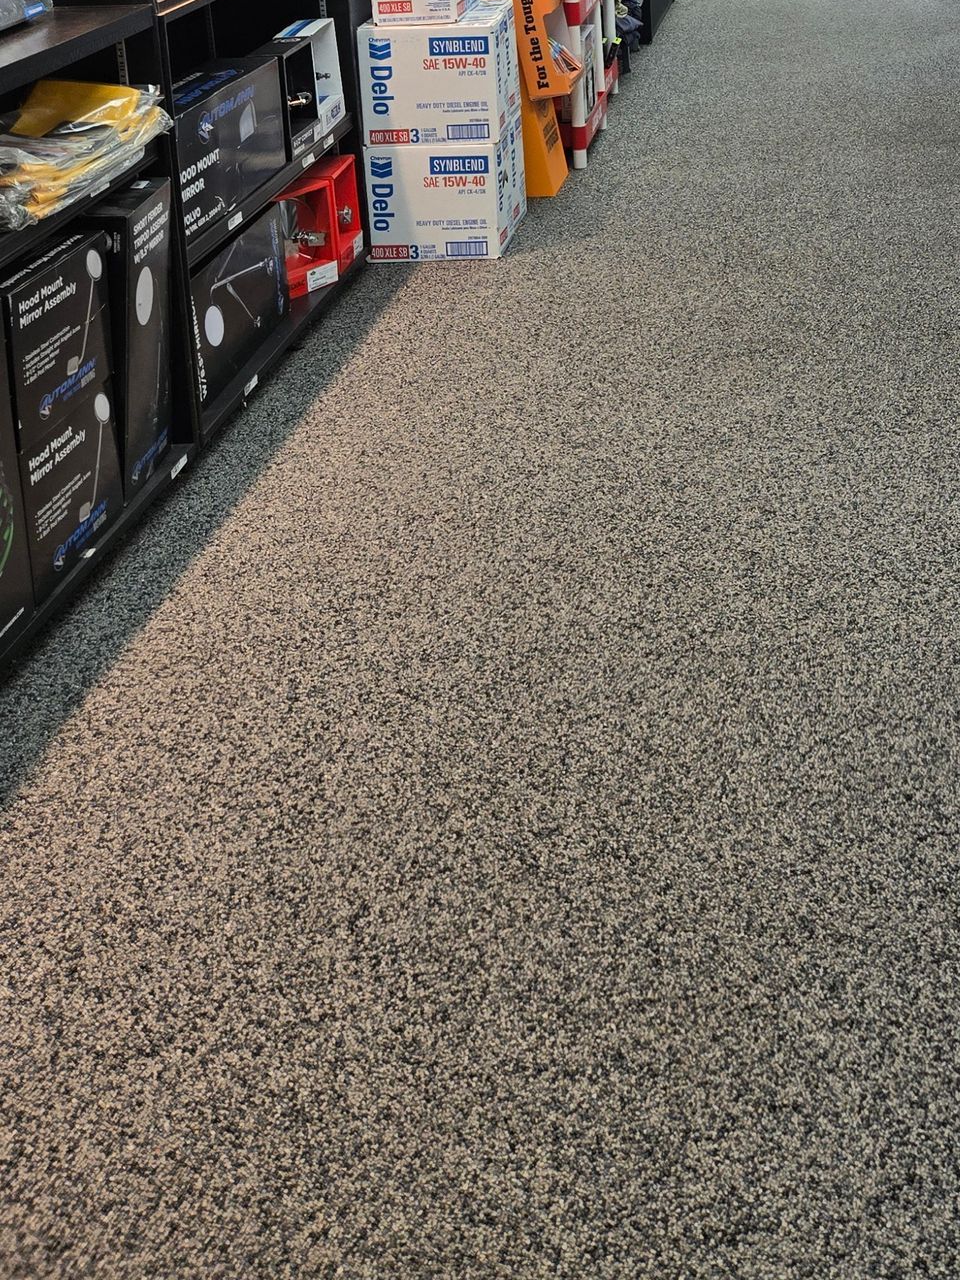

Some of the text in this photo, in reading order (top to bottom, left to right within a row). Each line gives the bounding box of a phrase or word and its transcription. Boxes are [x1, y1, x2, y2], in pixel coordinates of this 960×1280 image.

[379, 1, 411, 13] 400 XLE SB
[432, 39, 485, 53] SYNBLEND
[529, 38, 546, 66] the
[423, 57, 486, 70] SAE 15W-40
[370, 66, 394, 115] Delo
[536, 67, 549, 90] For
[198, 85, 255, 140] AUTOMANN
[371, 131, 409, 143] 400 XLE SB
[410, 128, 420, 143] 3
[197, 148, 220, 171] MOUNT
[433, 159, 484, 172] SYNBLEND
[423, 176, 486, 188] SAE 15W-40
[133, 218, 147, 235] SHORT
[148, 202, 163, 222] FENDER
[372, 184, 394, 232] Delo
[134, 210, 169, 250] TRIPOD ASSEMBLY
[150, 230, 163, 248] MIRROR
[371, 246, 408, 258] 400 XLE SB
[410, 245, 419, 259] 3
[18, 276, 63, 314] Hood Mount
[20, 282, 77, 329] Mirror Assembly
[39, 357, 96, 419] AUTOMANN
[29, 426, 73, 471] Hood Mount
[30, 429, 86, 486] Mirror Assembly
[53, 500, 107, 571] AUTOMANN
